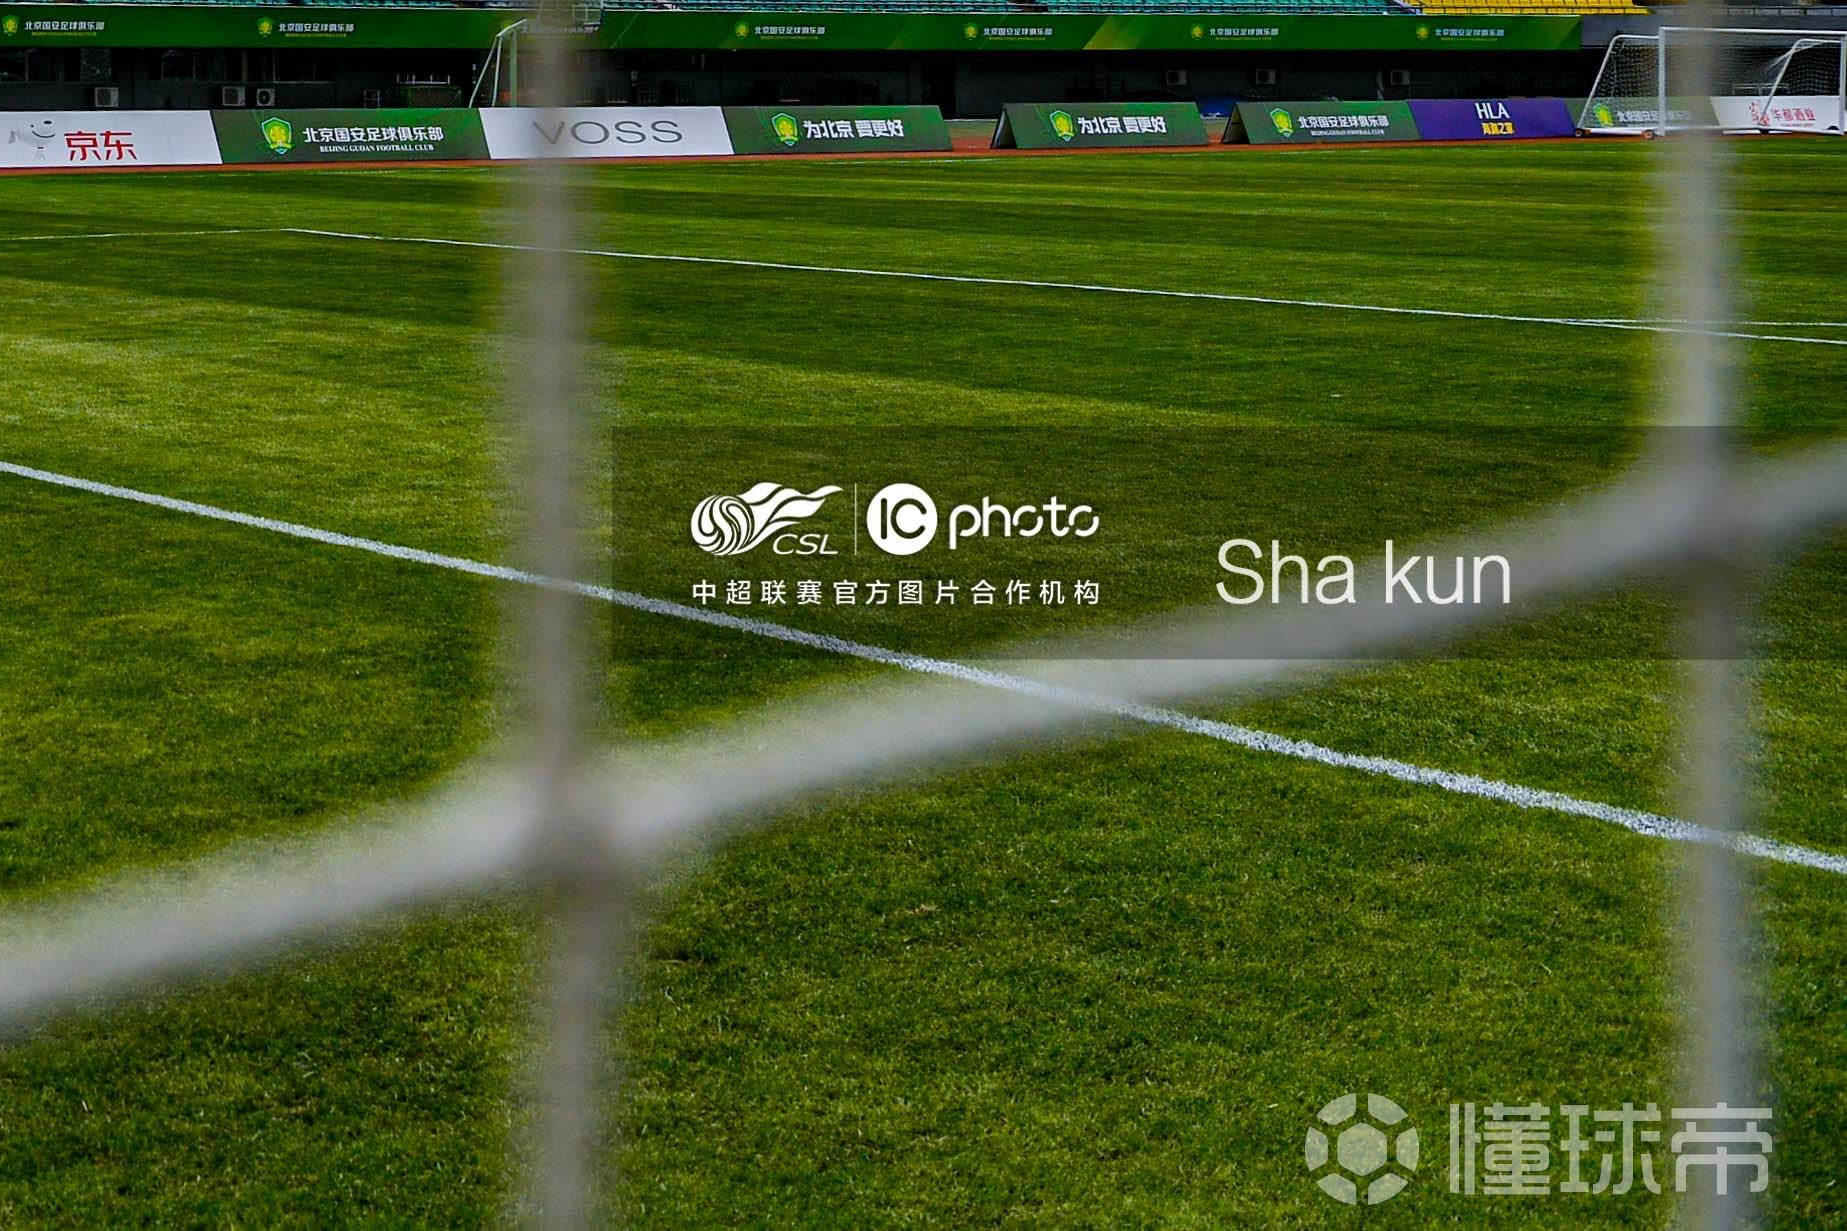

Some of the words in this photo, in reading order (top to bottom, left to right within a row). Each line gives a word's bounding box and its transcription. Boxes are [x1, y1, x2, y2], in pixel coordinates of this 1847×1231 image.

[24, 20, 105, 31] 北京国安足球俱乐部
[1474, 102, 1511, 119] HLA
[803, 120, 854, 139] 为北京
[855, 119, 904, 137] 要更好
[1078, 117, 1123, 134] 为北京
[1298, 115, 1389, 128] 北京国安足球俱乐部
[302, 127, 444, 143] 北京国安足球俱乐部
[532, 120, 683, 145] VOSS
[63, 131, 138, 161] 京东
[320, 145, 348, 153] BEIJING
[376, 144, 414, 152] FOOTBALL
